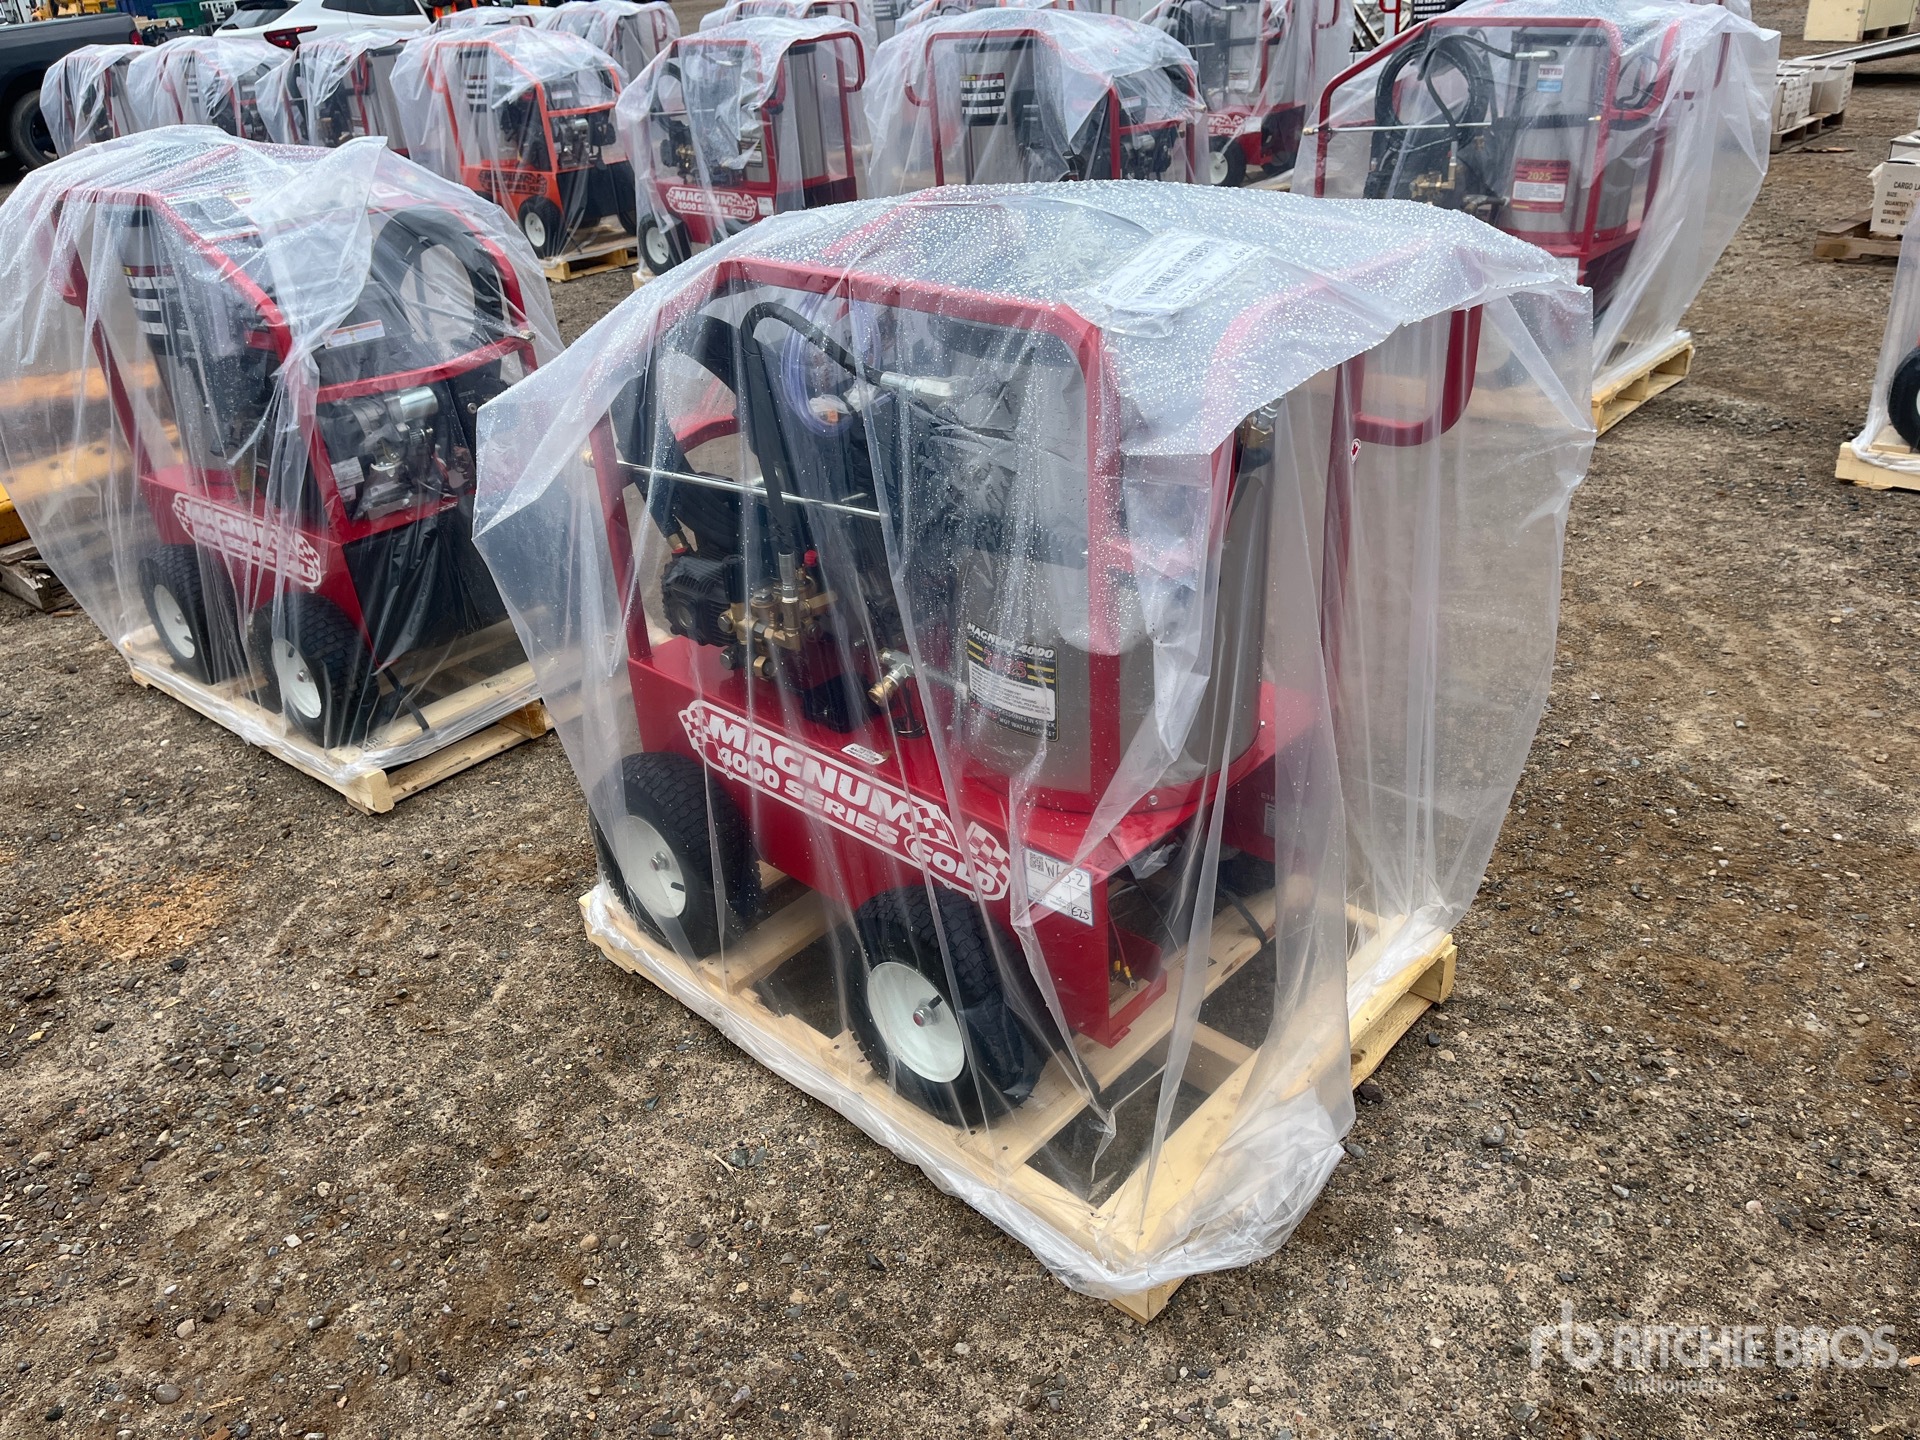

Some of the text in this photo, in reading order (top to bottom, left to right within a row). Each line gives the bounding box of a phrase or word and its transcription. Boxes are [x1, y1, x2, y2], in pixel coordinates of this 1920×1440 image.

[675, 190, 733, 206] MAGUM
[1893, 181, 1913, 190] CARGO
[708, 713, 911, 823] MAGNUM
[718, 747, 780, 790] 4000
[784, 778, 900, 846] SERIES
